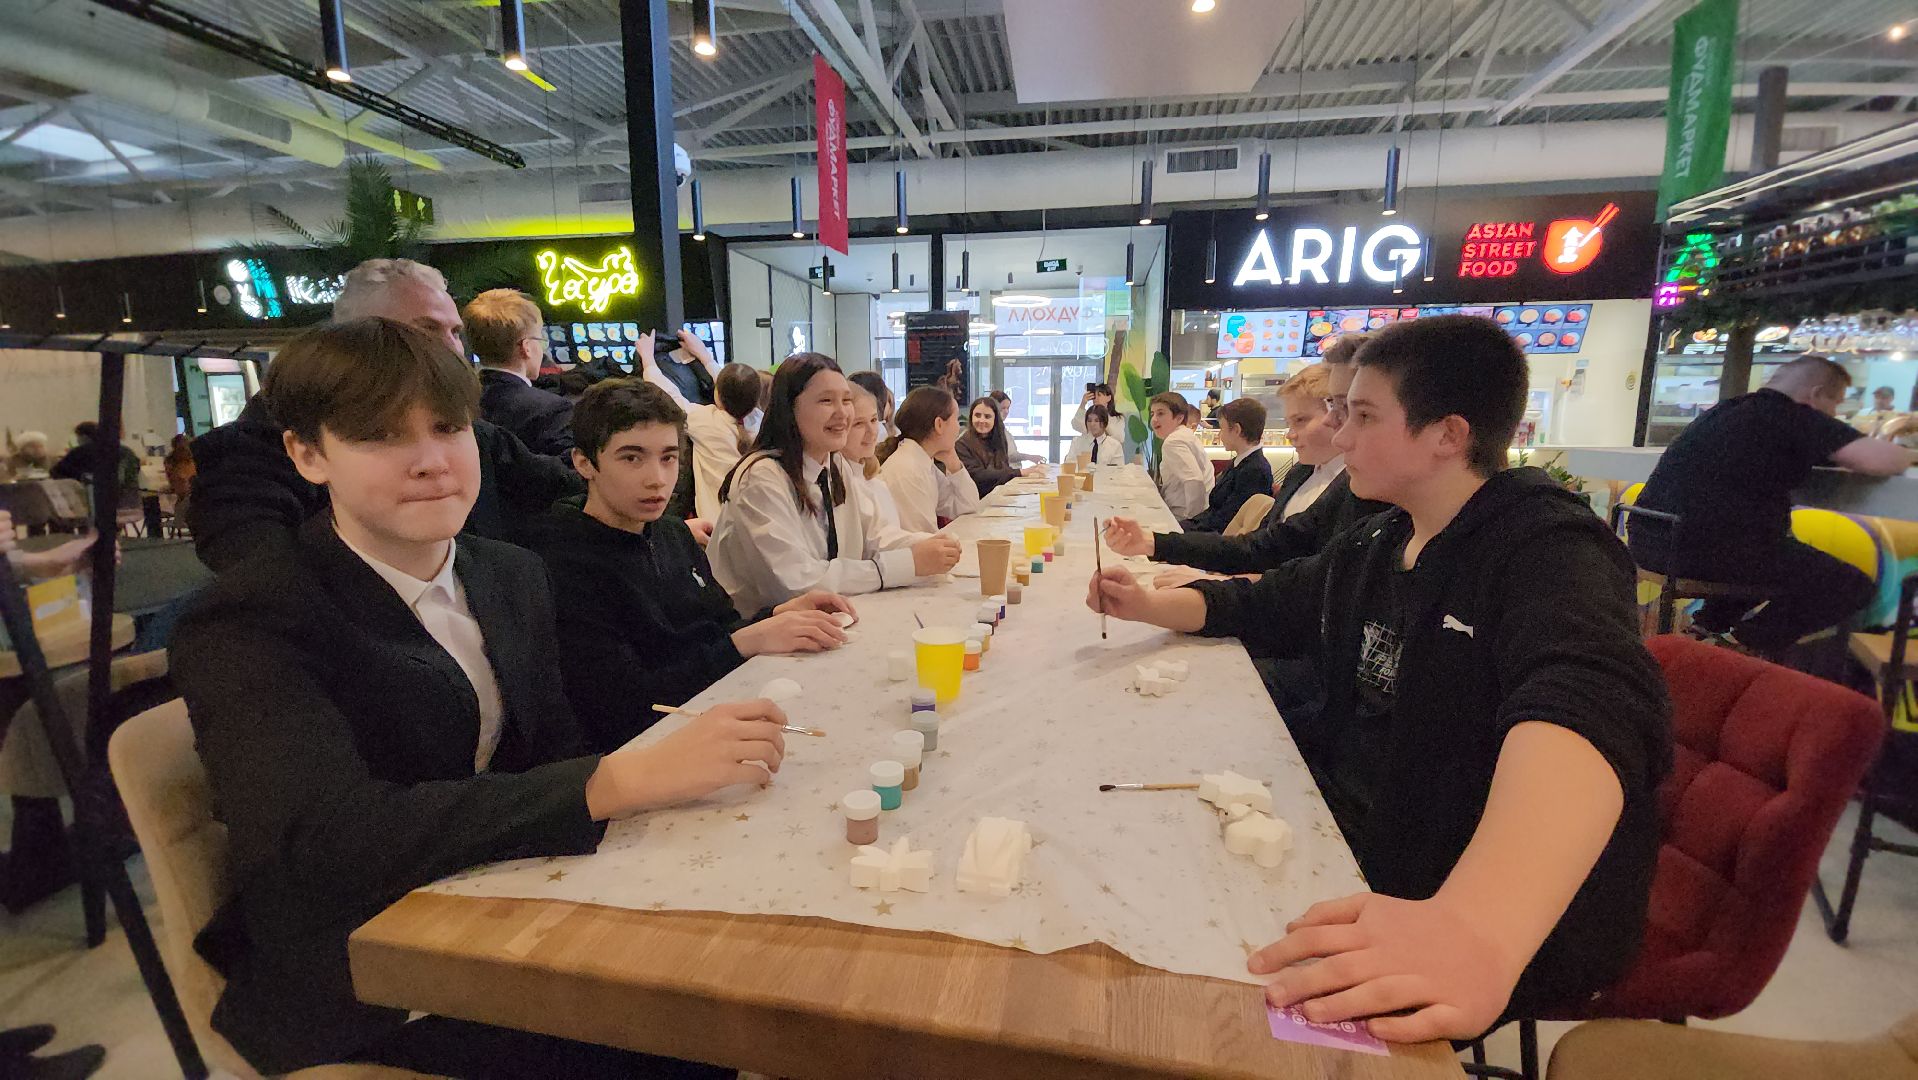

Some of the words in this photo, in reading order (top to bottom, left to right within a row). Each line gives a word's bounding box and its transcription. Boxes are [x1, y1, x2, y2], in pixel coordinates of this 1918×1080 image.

[1467, 221, 1534, 240] ASIAN
[1232, 224, 1421, 286] ARIG
[1462, 240, 1536, 259] STREET
[1458, 259, 1519, 278] FOOD
